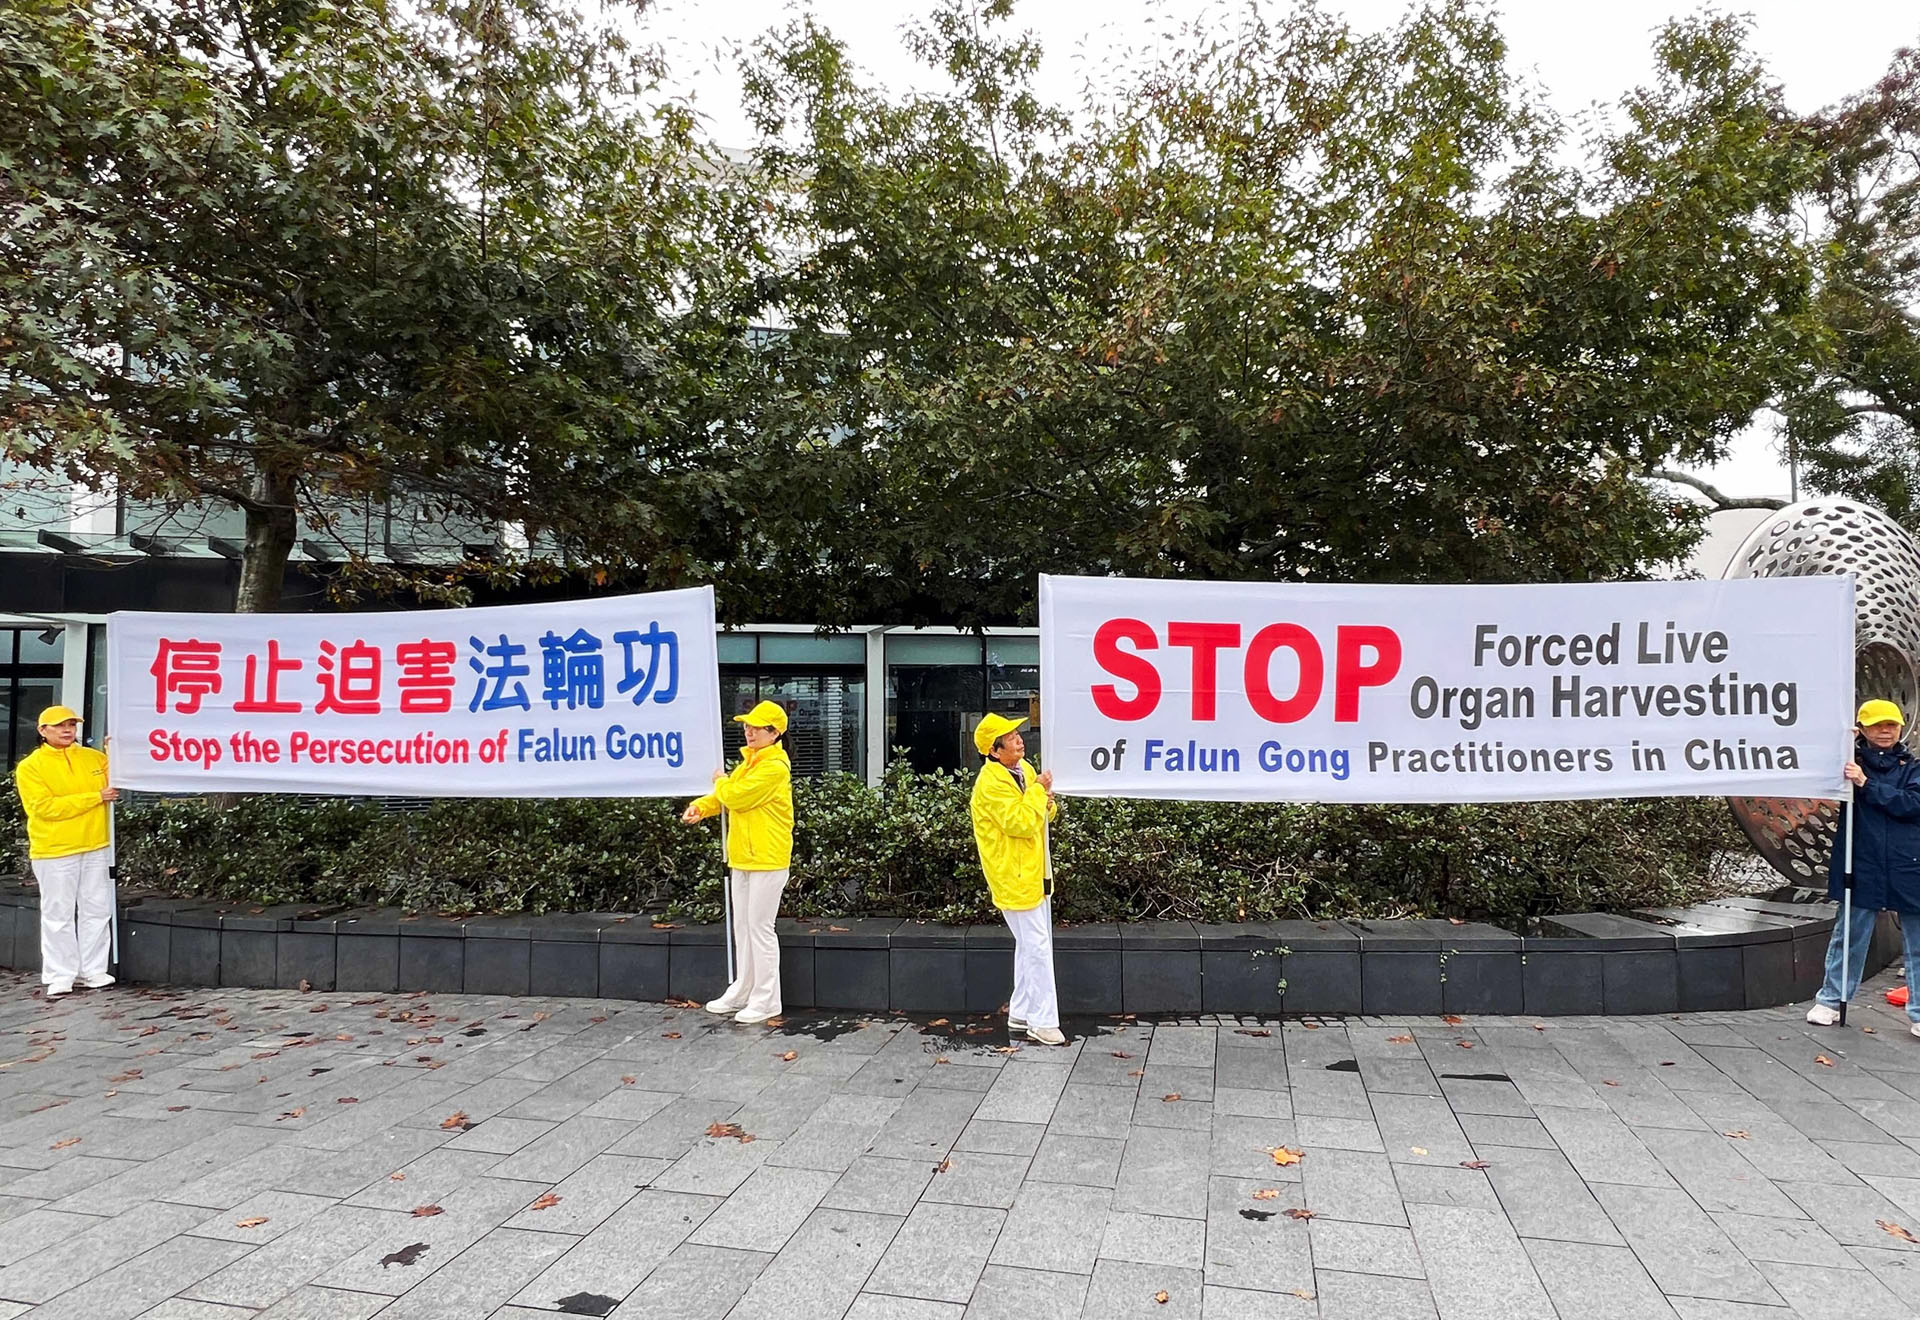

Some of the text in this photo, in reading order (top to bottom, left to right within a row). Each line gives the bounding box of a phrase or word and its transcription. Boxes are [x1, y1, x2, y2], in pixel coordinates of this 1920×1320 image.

[150, 621, 680, 715] 停止迫害法輪功
[1475, 622, 1728, 667] Forced Live
[1091, 618, 1403, 724] STOP
[1411, 673, 1798, 730] Organ Harvesting
[149, 725, 684, 769] Stop the Persecution of Falun Gong
[1091, 739, 1799, 781] of Falun Gong Practitioners in China
